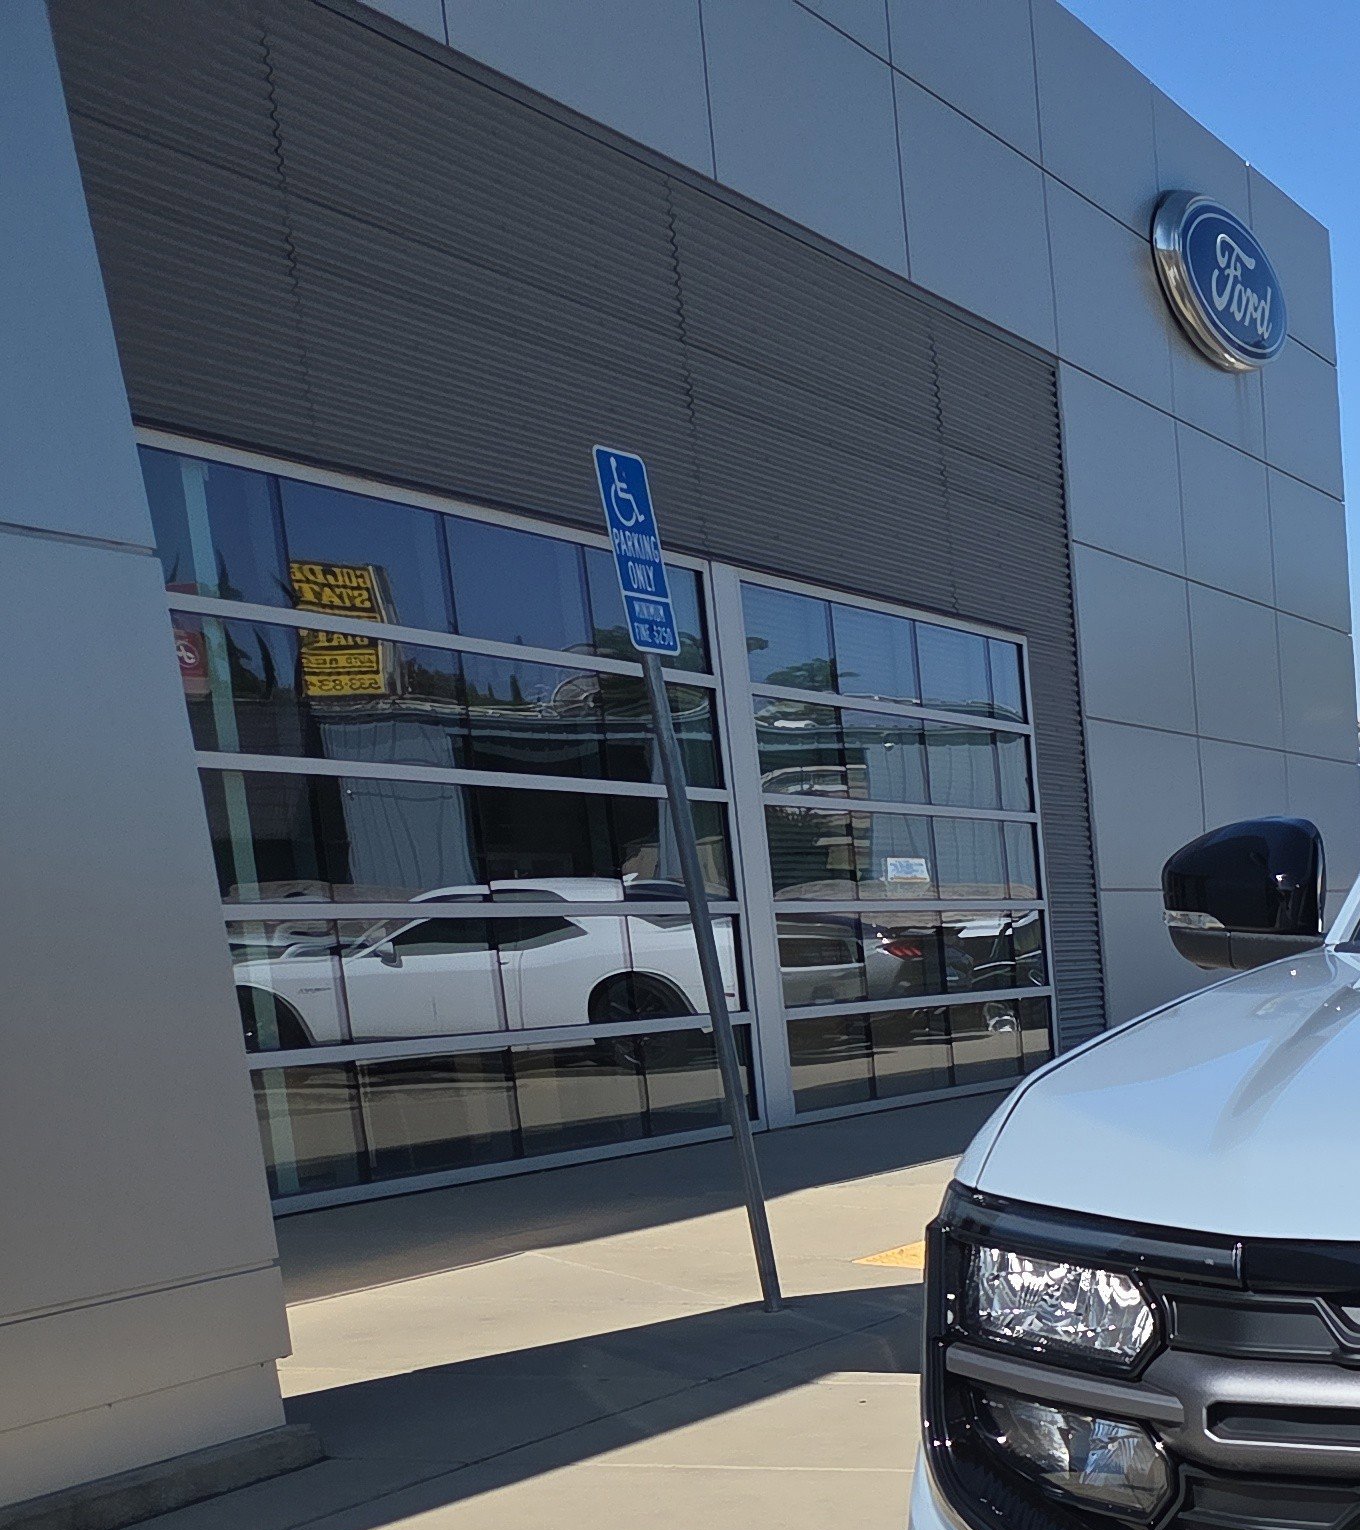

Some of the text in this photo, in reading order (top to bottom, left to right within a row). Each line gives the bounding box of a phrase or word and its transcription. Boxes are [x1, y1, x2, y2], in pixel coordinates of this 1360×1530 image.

[1211, 233, 1272, 340] Ford
[612, 528, 660, 563] PARKING
[627, 560, 656, 592] ONLY
